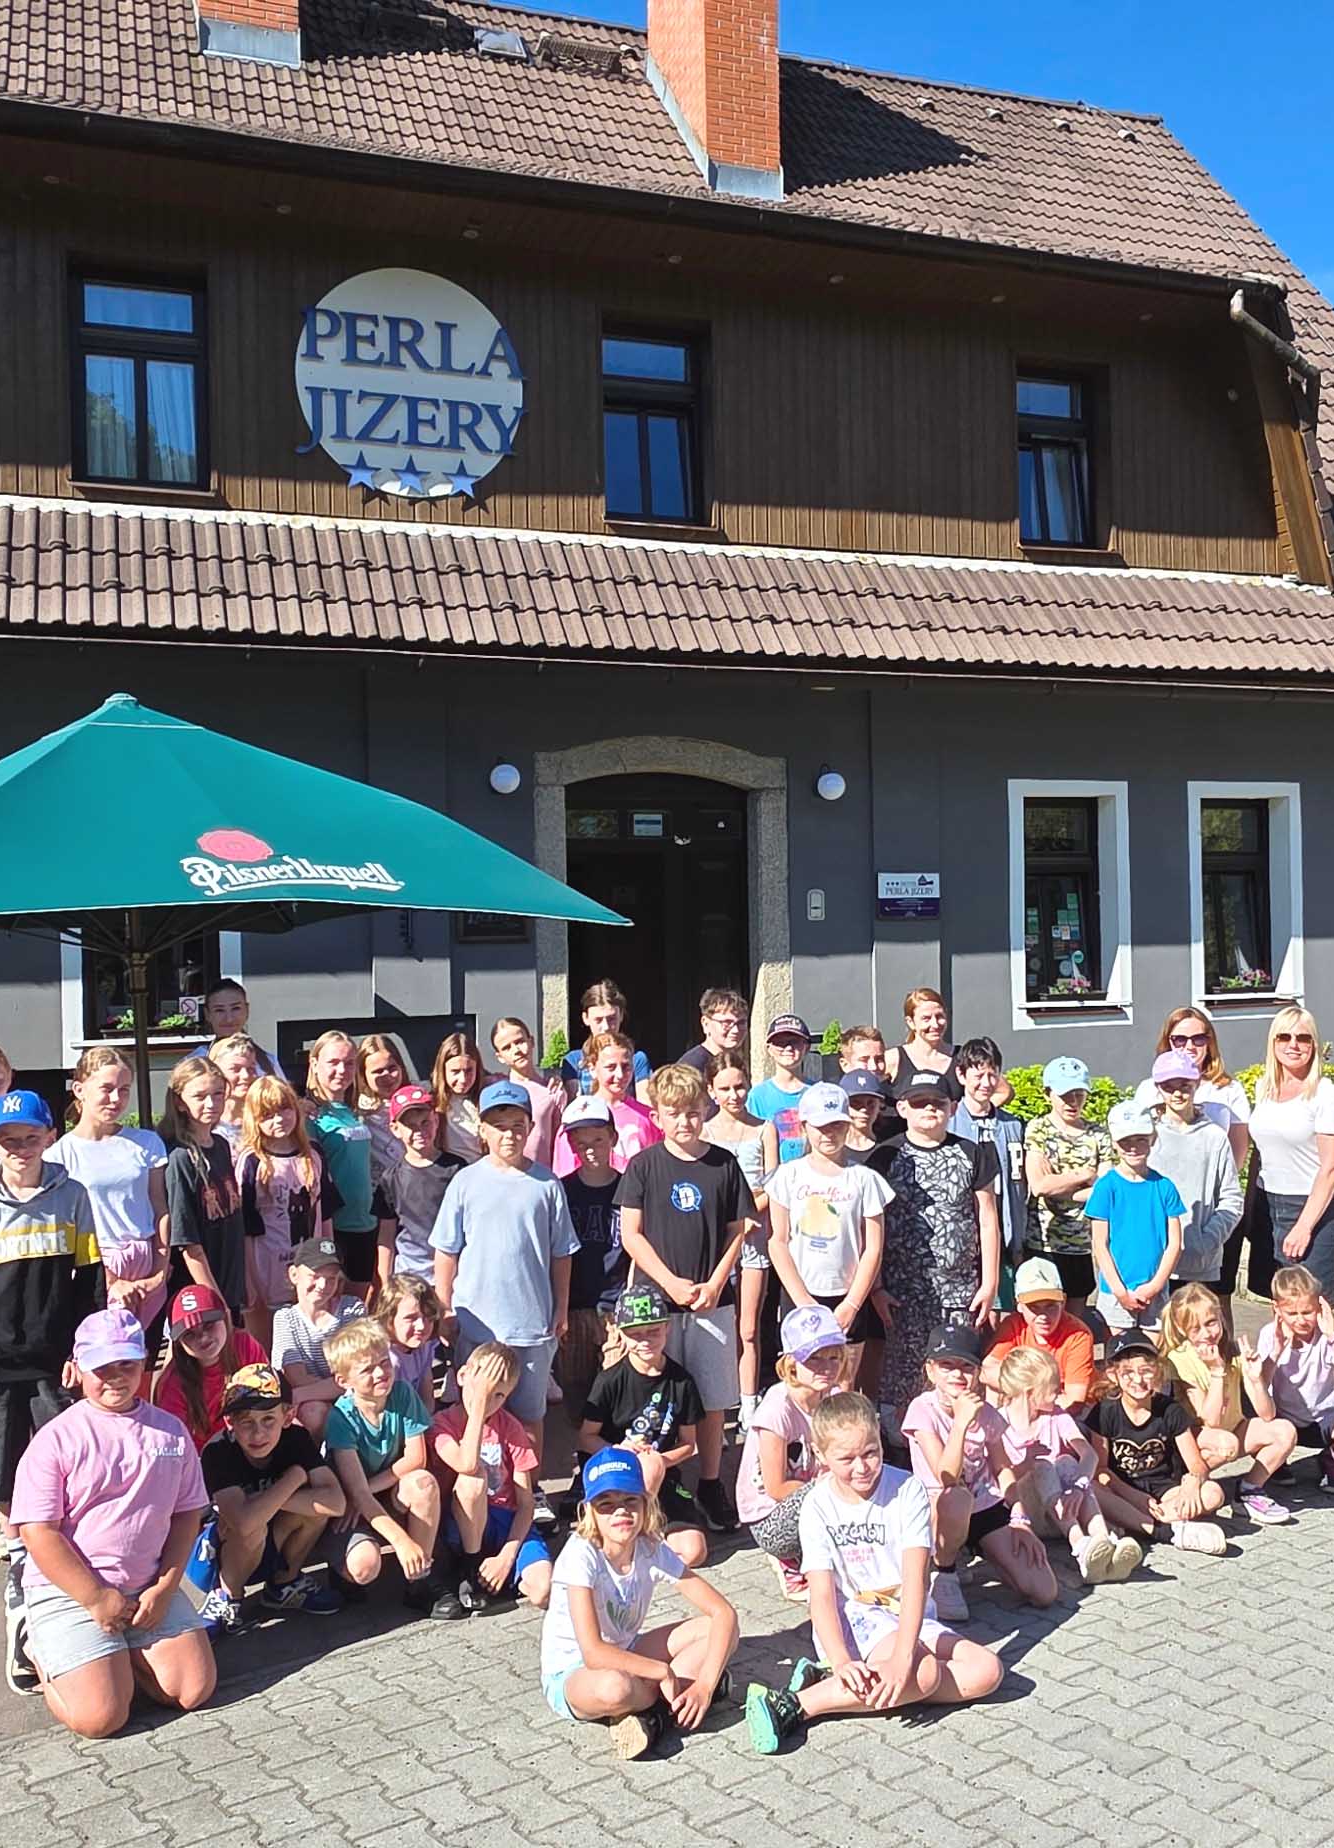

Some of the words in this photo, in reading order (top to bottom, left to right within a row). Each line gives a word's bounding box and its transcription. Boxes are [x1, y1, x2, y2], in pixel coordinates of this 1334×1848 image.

[301, 304, 529, 380] PERLA
[294, 386, 528, 457] JIZERY
[180, 857, 297, 896] Pilsner
[284, 856, 398, 889] Urquell
[2, 1095, 21, 1113] NY
[182, 1294, 197, 1311] S
